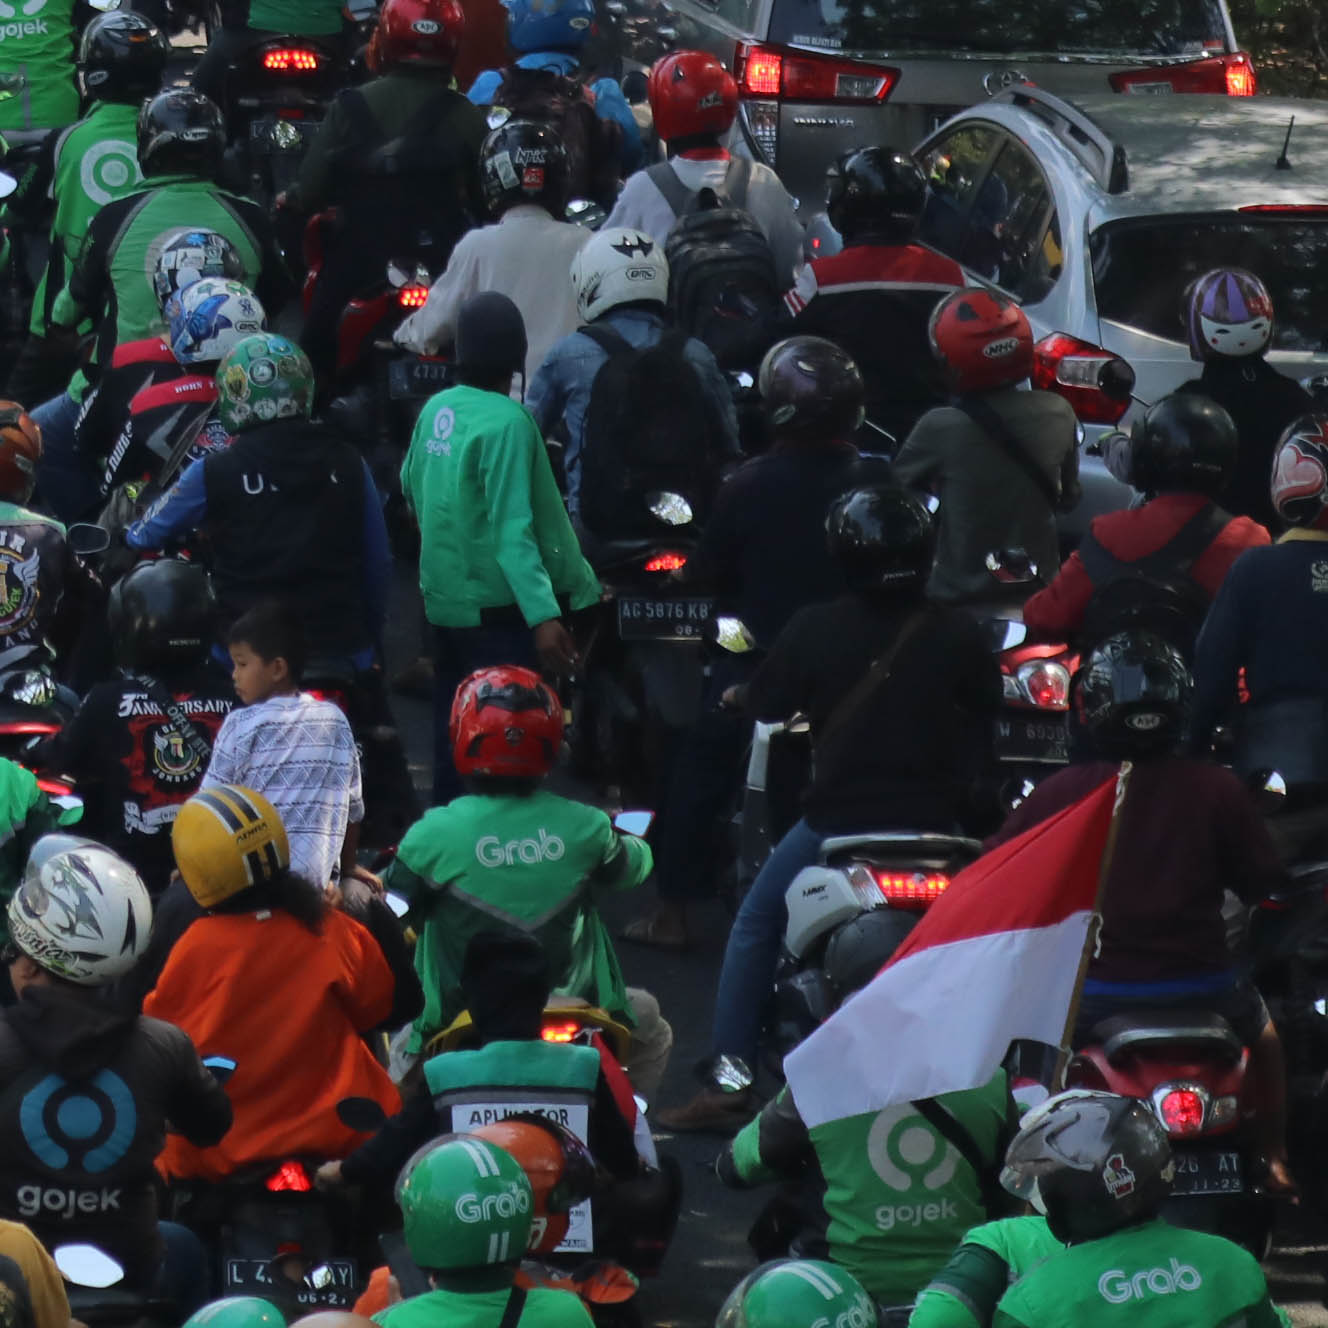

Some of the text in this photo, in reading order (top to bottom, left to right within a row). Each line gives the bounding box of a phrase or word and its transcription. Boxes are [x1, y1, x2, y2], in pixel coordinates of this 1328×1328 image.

[646, 603, 685, 619] 5876
[476, 829, 565, 868] Grab
[17, 1185, 122, 1218] gojek
[455, 1186, 531, 1225] Grab
[875, 1199, 958, 1231] gojek
[1099, 1258, 1202, 1305] Grab
